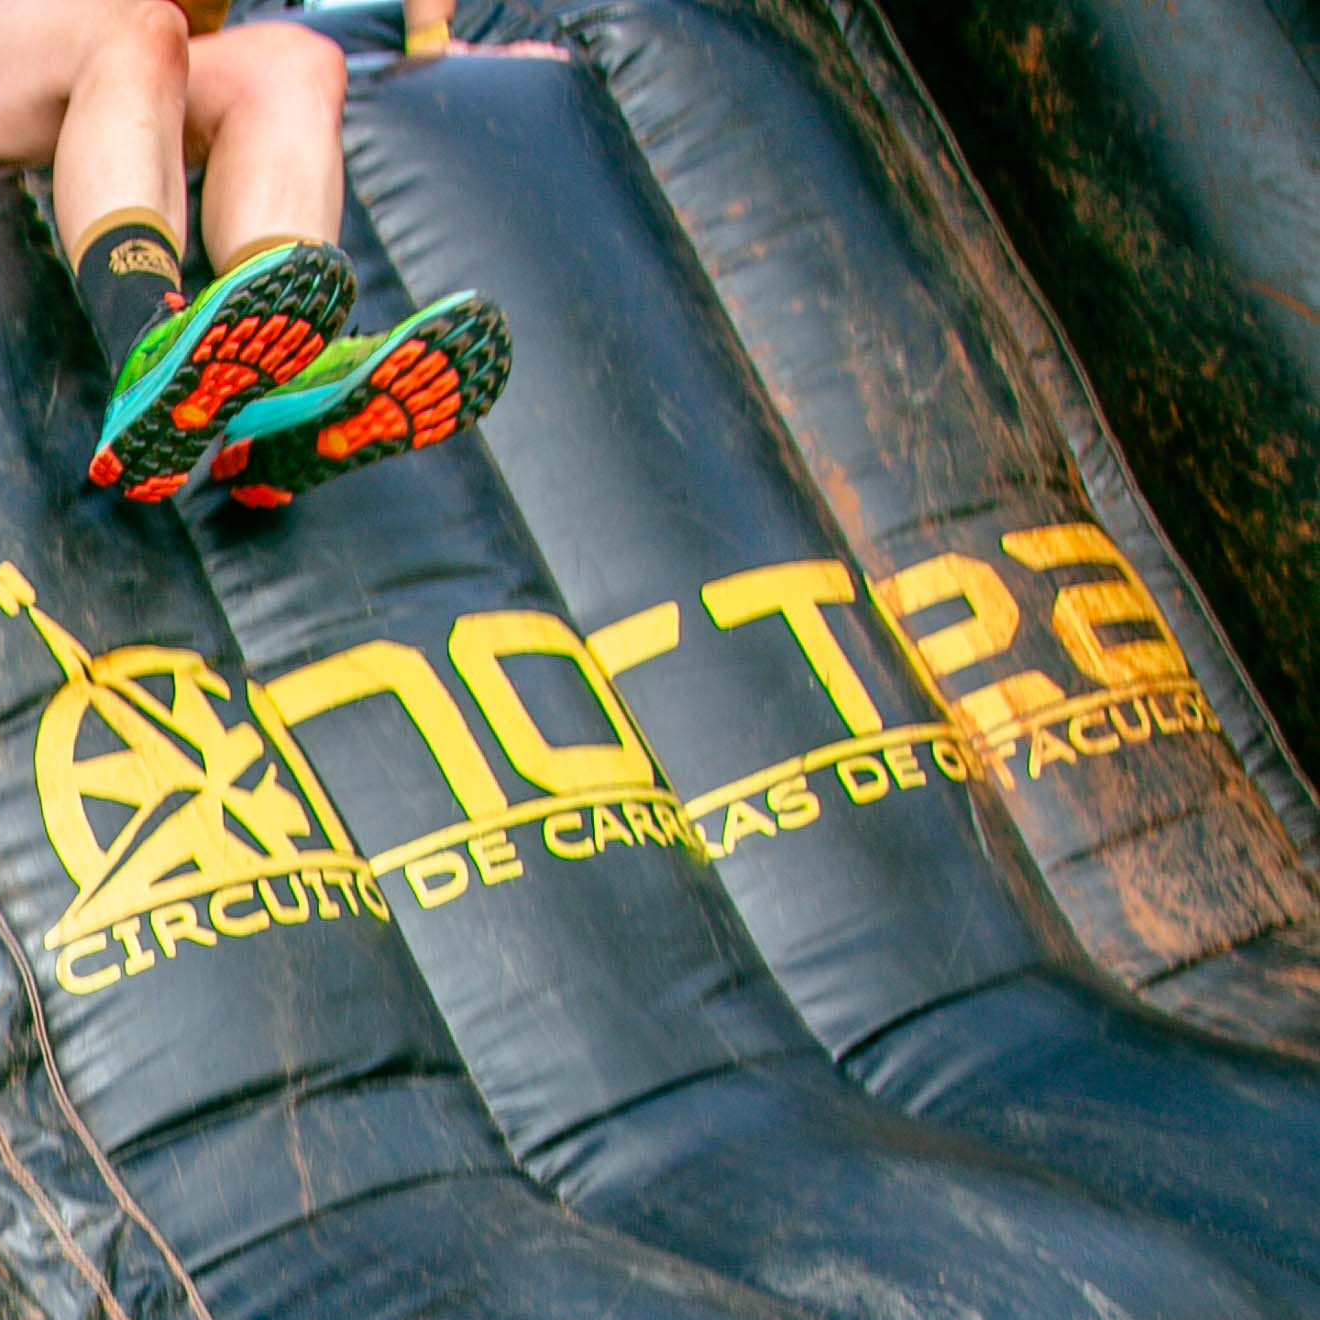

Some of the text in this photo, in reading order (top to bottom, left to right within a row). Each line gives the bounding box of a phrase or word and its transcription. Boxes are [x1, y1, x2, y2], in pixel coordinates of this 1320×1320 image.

[55, 864, 391, 996] CIRCUITO
[404, 830, 524, 910] DE
[835, 740, 927, 806] DE
